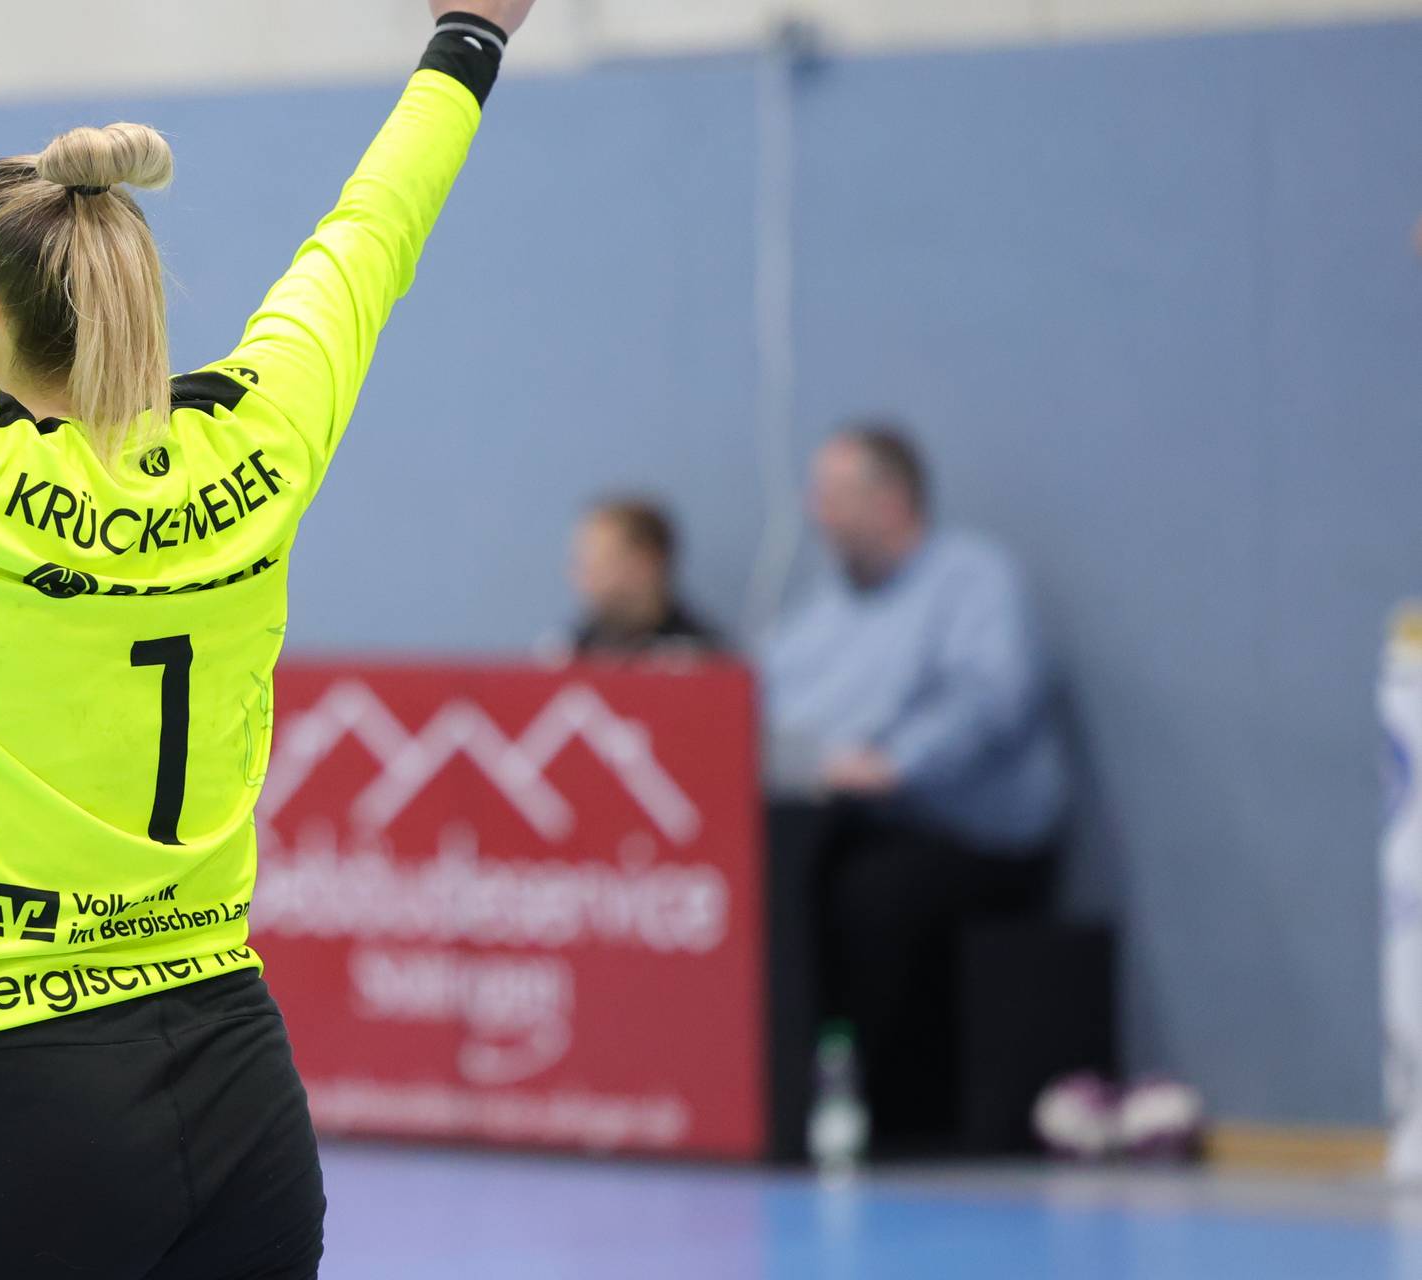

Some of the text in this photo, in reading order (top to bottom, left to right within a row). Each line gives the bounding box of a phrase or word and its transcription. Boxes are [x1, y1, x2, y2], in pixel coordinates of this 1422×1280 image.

[68, 901, 250, 945] im Bergischen Lan
